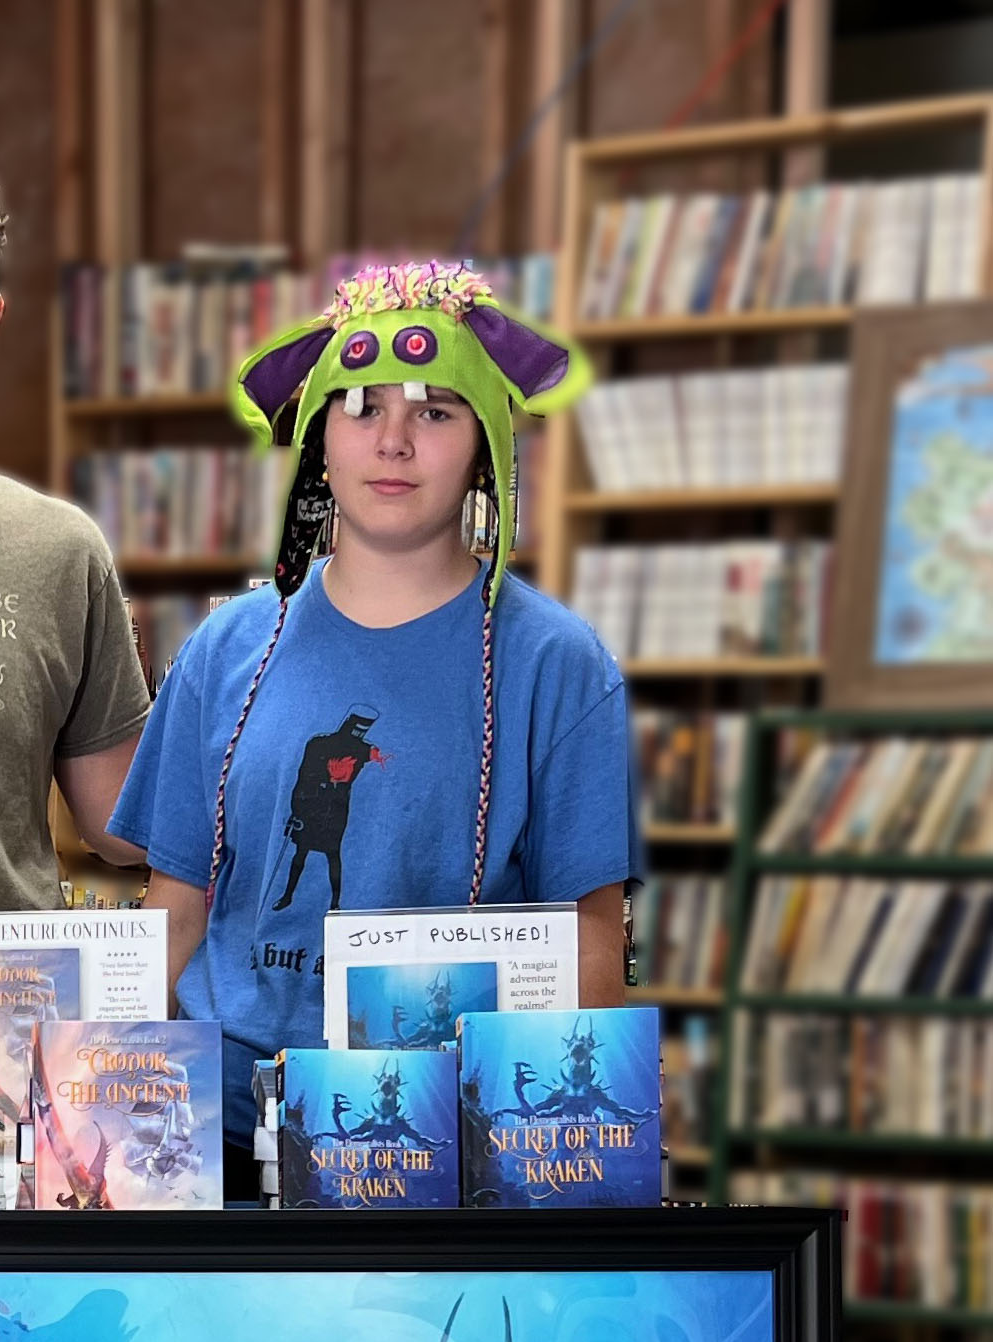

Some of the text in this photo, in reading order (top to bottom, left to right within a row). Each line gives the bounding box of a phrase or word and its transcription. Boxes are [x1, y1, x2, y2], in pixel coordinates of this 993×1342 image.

[348, 924, 550, 947] JUST PUBLISHED!
[263, 942, 308, 973] but
[521, 959, 558, 971] magical
[509, 974, 556, 984] adventure
[510, 987, 556, 997] across the
[486, 1124, 637, 1158] SECRET OF THE
[307, 1149, 435, 1176] SECRET OF THE
[517, 1158, 604, 1195] KRAKEN
[335, 1177, 407, 1206] KRAKEN
